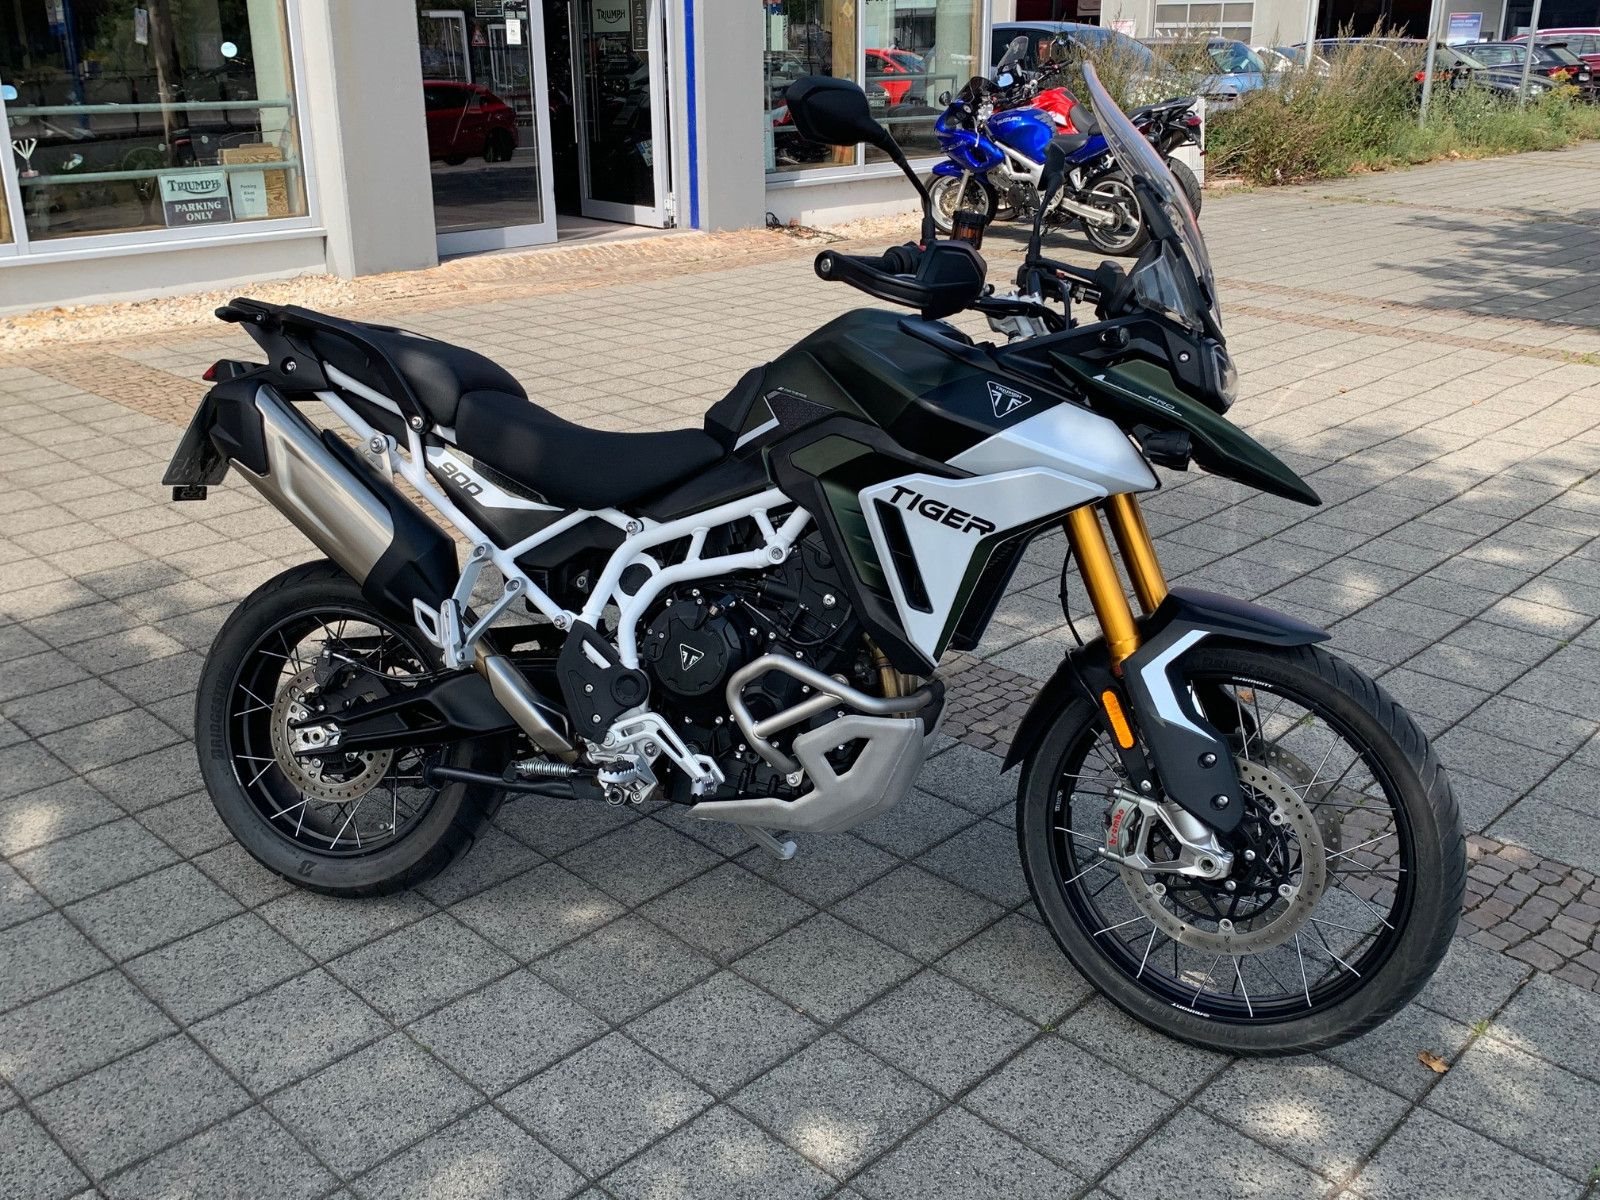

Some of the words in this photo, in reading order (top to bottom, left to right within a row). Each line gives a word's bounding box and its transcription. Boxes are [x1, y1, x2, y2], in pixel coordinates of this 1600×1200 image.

[597, 9, 626, 21] TRIUMPH
[996, 116, 1022, 125] SUZUKI
[167, 179, 221, 193] TRIUMPH
[175, 201, 221, 212] PARKING
[186, 211, 213, 221] ONLY
[995, 385, 1022, 399] TRIUMPH
[1148, 395, 1175, 410] PRO
[442, 462, 484, 496] 900
[890, 484, 996, 536] TIGER
[1108, 808, 1125, 846] brembo
